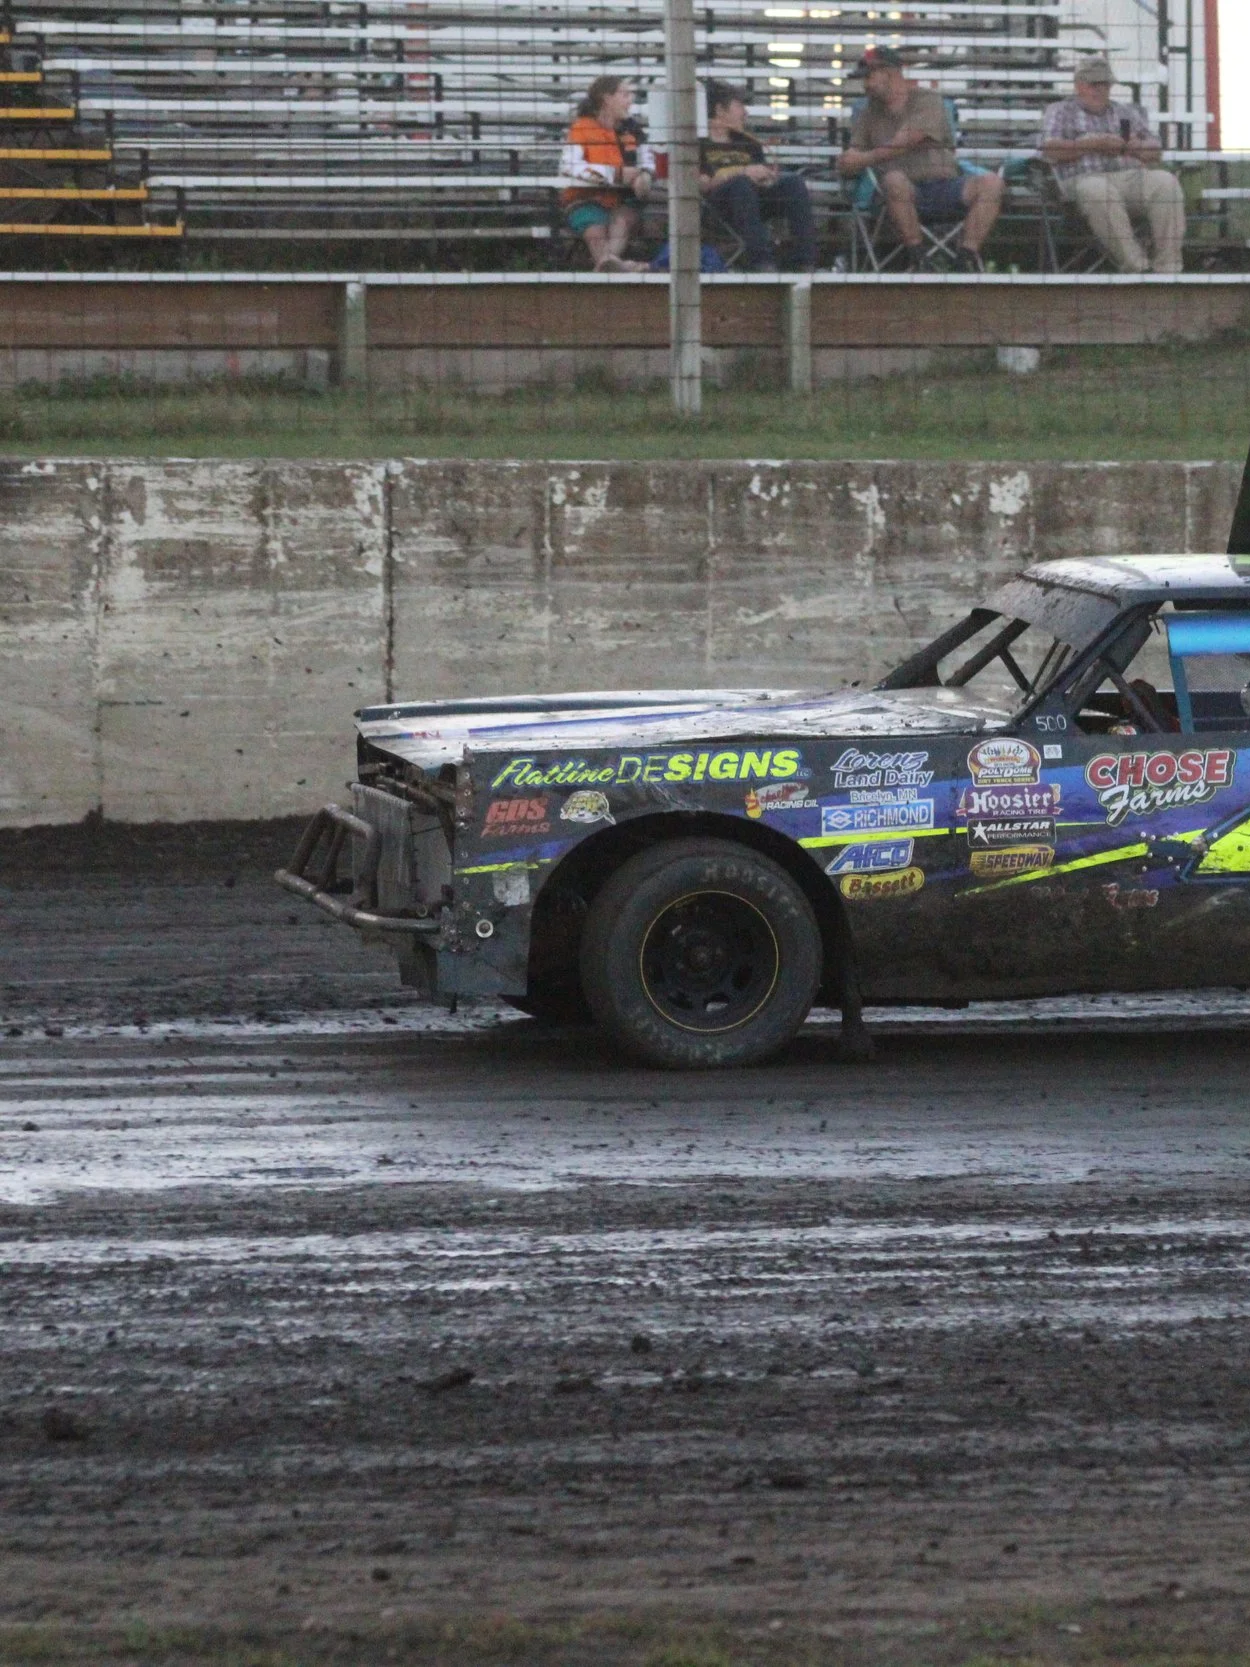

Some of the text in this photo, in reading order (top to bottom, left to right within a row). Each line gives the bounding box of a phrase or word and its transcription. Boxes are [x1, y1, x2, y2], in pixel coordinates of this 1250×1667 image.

[1036, 714, 1067, 731] 500
[491, 758, 616, 788] Flatline
[615, 750, 800, 784] DESIGNS
[830, 748, 930, 773] Lorenz
[1086, 750, 1233, 789] CHOSE
[834, 769, 935, 788] Land Dairy
[767, 799, 819, 811] RACING OIL
[897, 787, 918, 801] MN
[967, 787, 1052, 814] Hoosier
[1100, 781, 1212, 823] Farms
[854, 805, 930, 829] RICHMOND
[993, 807, 1048, 817] RACING TIRE
[986, 821, 1051, 832] ALLSTAR
[987, 831, 1052, 841] PERFORMANCE
[828, 839, 913, 874] AFCO
[983, 851, 1054, 873] SPEEDWAY
[849, 871, 917, 894] Bassett
